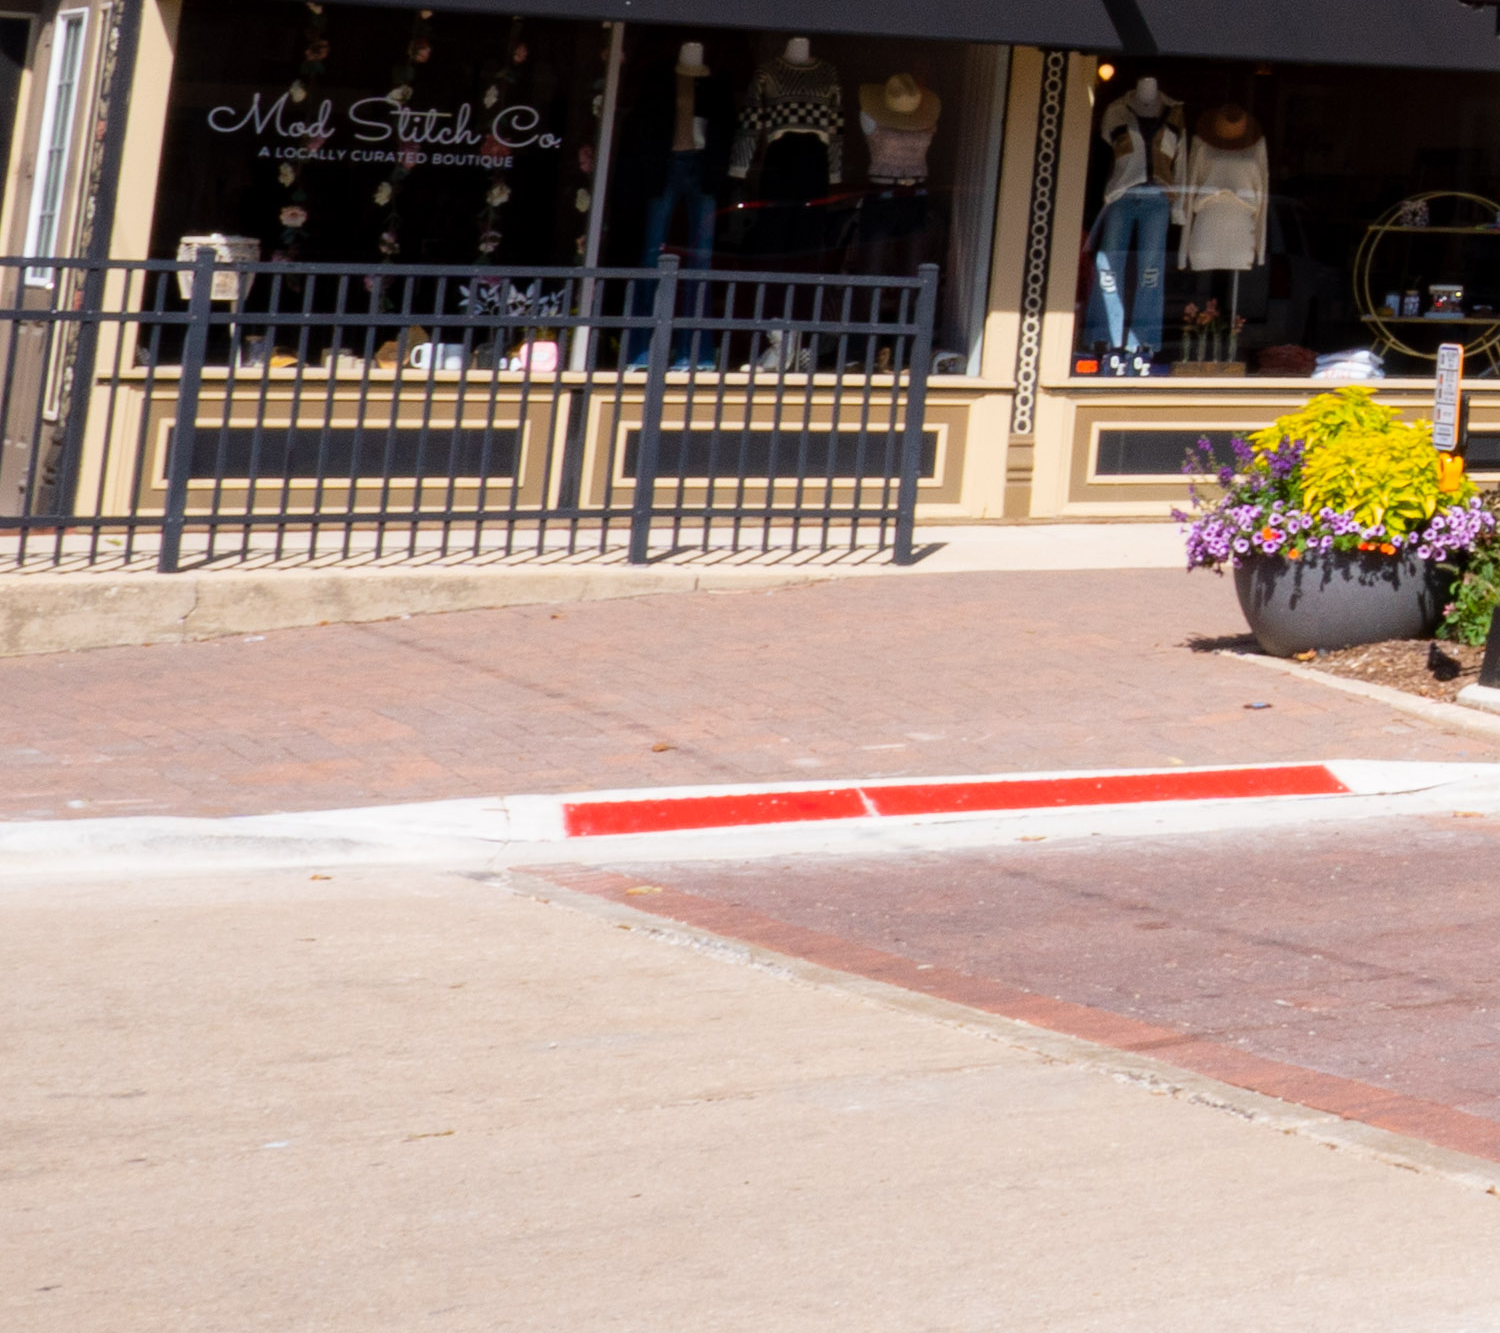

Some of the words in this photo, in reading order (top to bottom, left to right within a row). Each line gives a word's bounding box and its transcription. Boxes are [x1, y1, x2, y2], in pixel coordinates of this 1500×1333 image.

[208, 92, 335, 138] Mod
[349, 96, 481, 145] Stitch
[491, 105, 561, 149] Co.
[258, 147, 270, 158] A
[275, 148, 346, 161] LOCALLY
[351, 150, 427, 165] CURATED
[432, 153, 513, 168] BOUTIQUE
